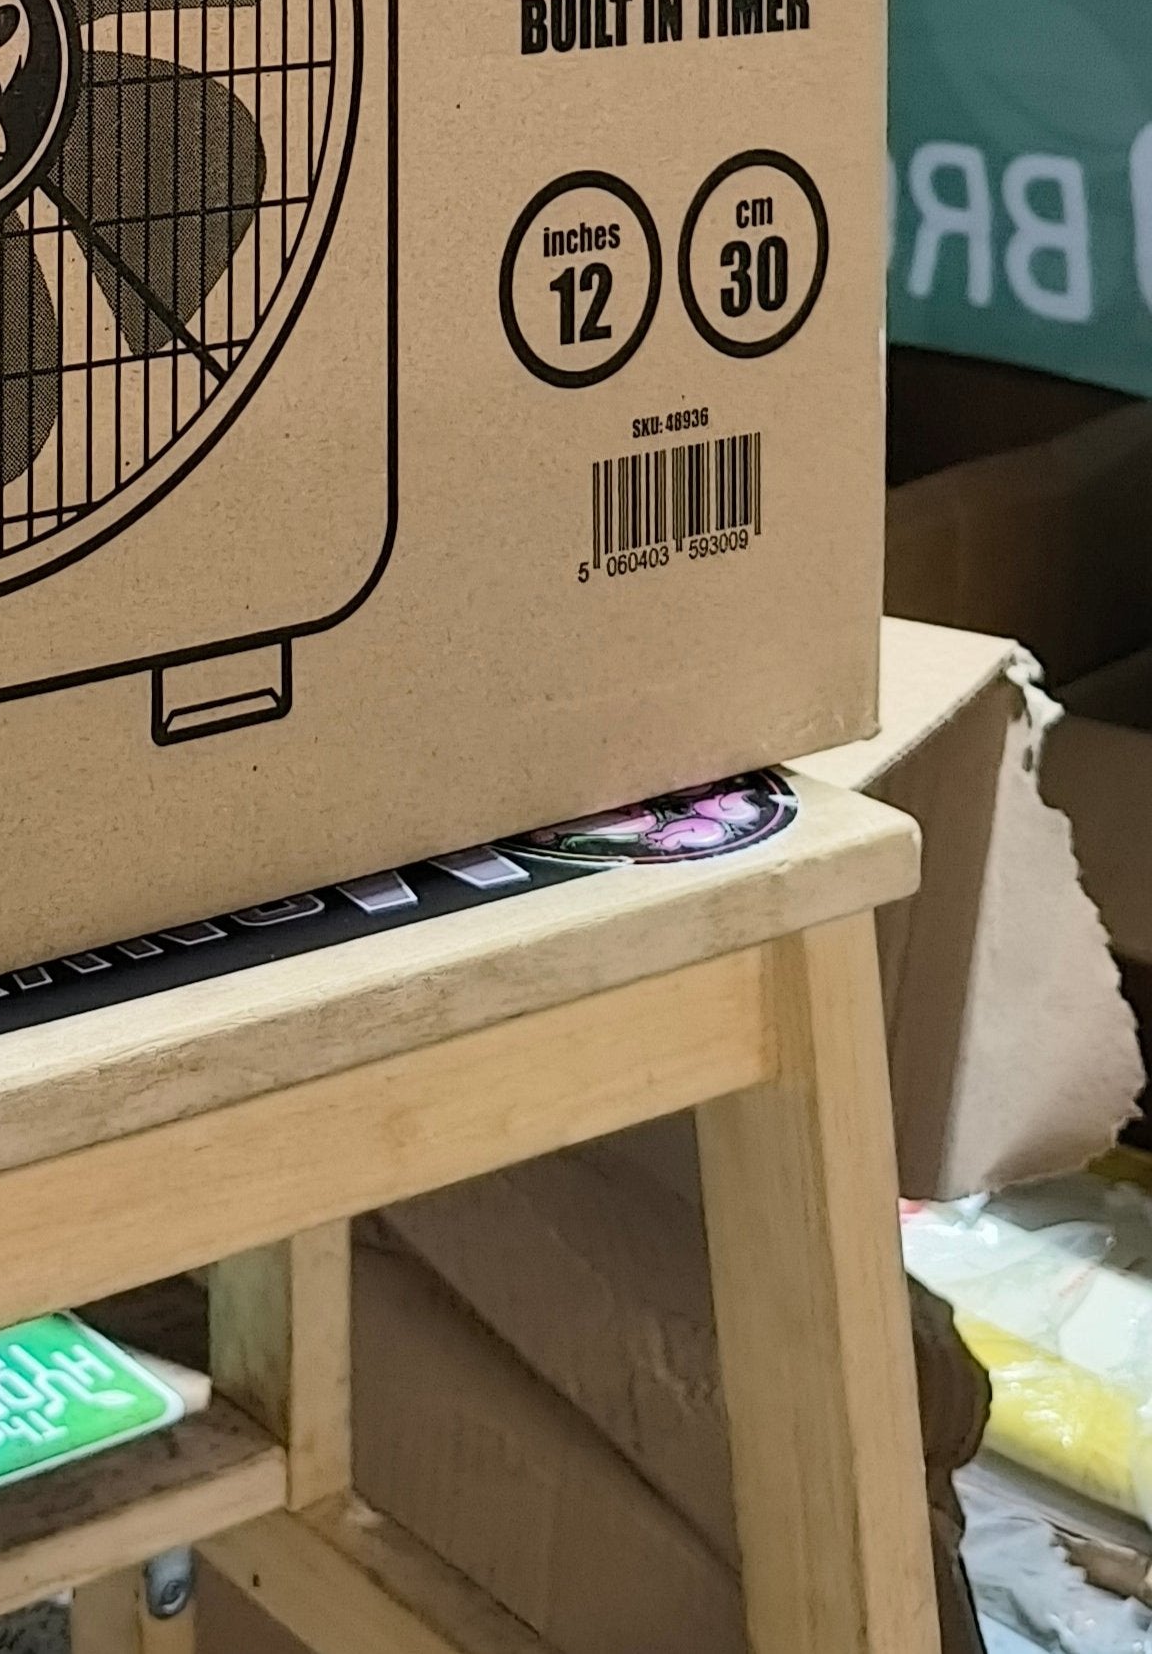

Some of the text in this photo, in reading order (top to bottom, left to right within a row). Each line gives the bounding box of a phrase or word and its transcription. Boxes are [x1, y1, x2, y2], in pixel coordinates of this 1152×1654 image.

[735, 196, 773, 229] cm
[543, 221, 621, 257] inches
[720, 235, 789, 318] 30
[549, 262, 613, 346] 12
[632, 407, 709, 439] SKU: 48936
[578, 529, 749, 584] 5 060403 593009
